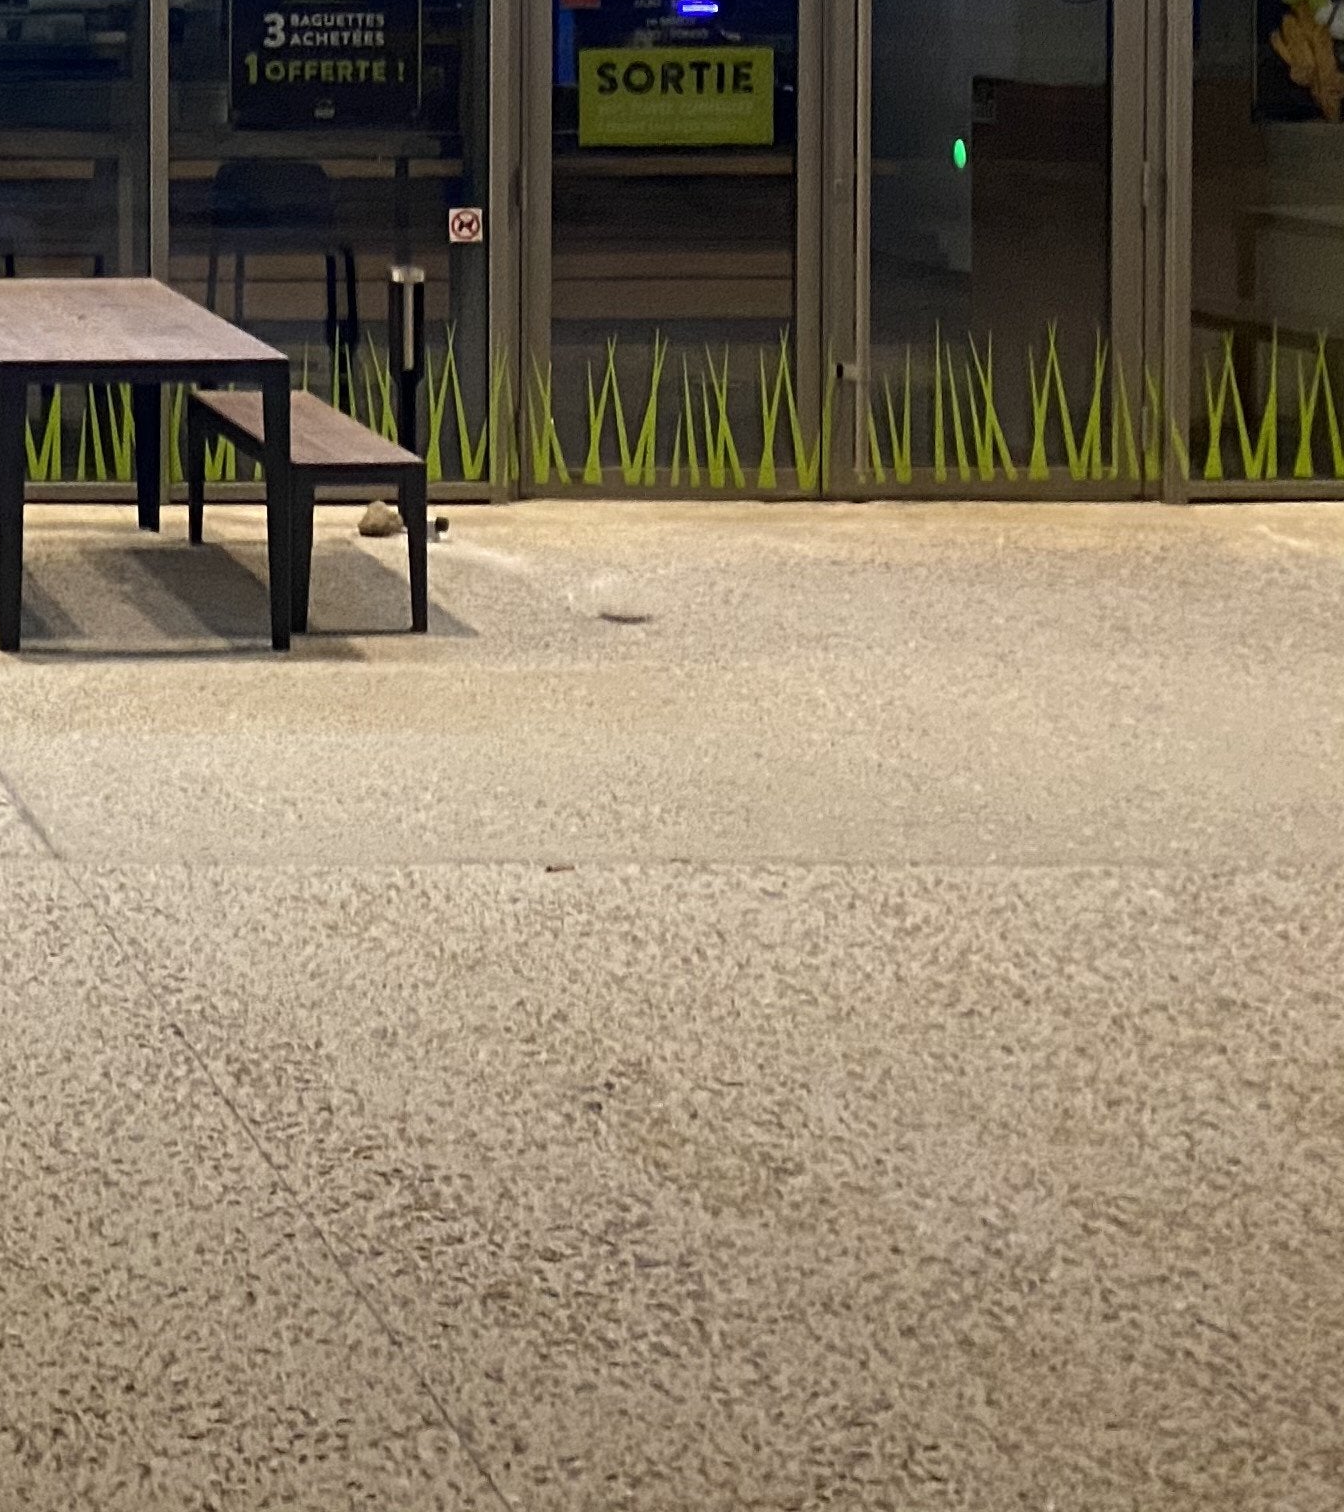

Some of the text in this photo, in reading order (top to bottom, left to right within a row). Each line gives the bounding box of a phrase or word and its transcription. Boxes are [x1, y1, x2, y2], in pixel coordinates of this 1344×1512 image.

[262, 12, 386, 49] 3 BAGUETTES
[289, 28, 386, 48] ACHETÉES
[264, 59, 387, 85] OFFERTE
[595, 60, 755, 96] SORTIE
